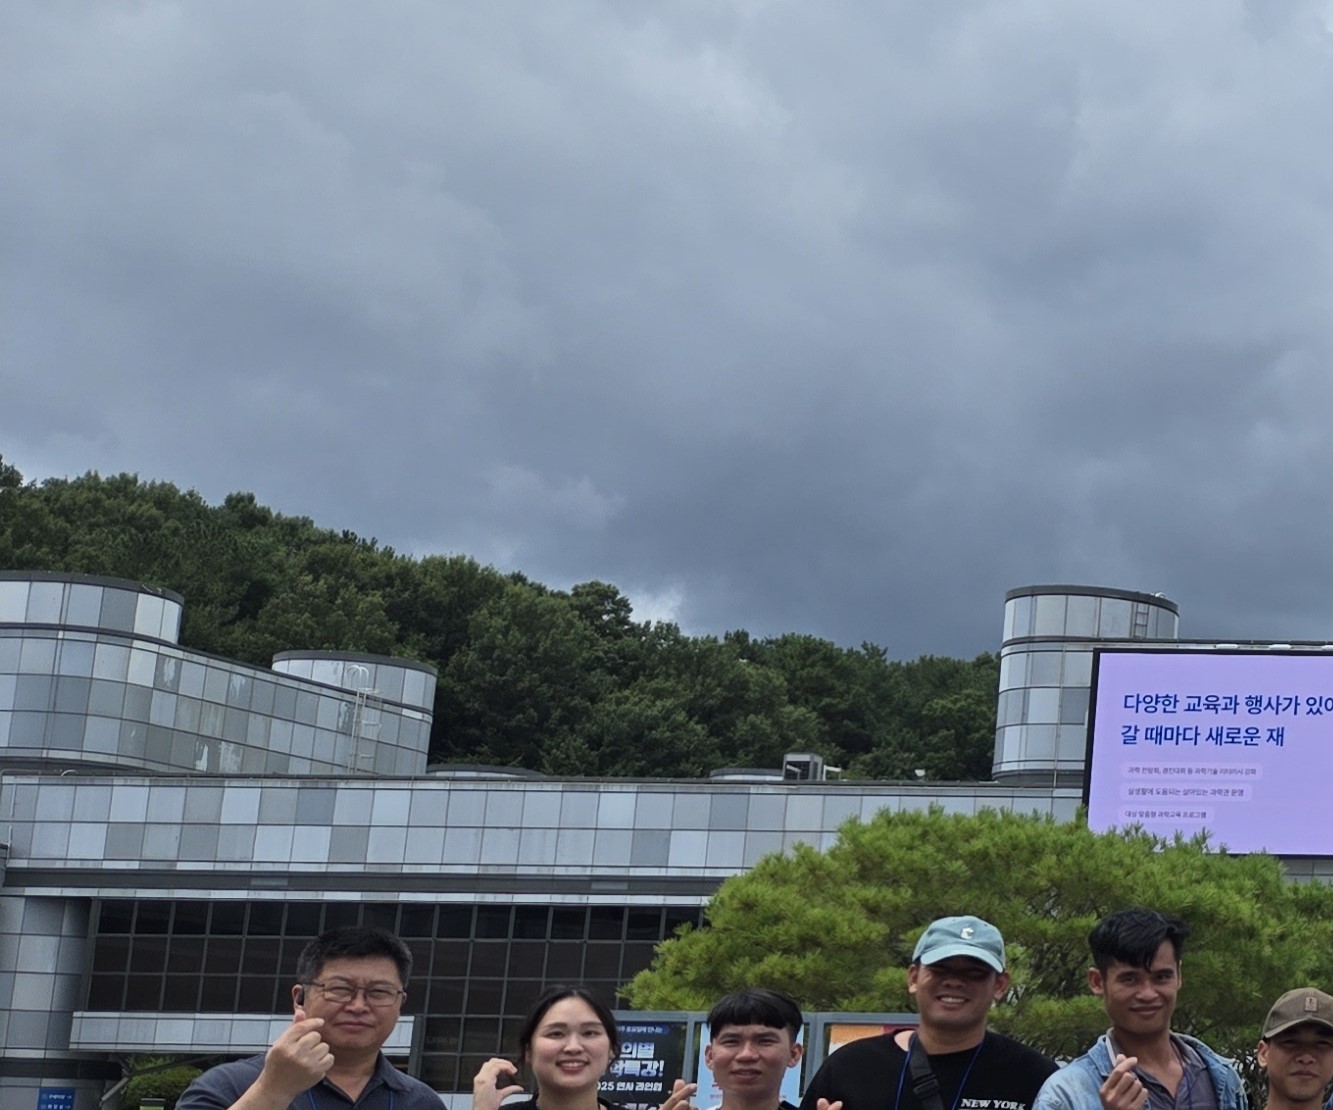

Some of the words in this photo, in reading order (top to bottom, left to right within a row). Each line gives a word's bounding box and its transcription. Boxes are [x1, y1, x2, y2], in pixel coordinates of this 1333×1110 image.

[1123, 693, 1181, 714] 다양한
[1184, 695, 1240, 715] 교육과
[1244, 695, 1302, 716] 행사가
[1121, 725, 1140, 746] 갈
[1145, 725, 1202, 746] 때마다
[1205, 726, 1262, 747] 새로운
[1265, 727, 1286, 747] 재
[960, 1098, 992, 1109] NEW
